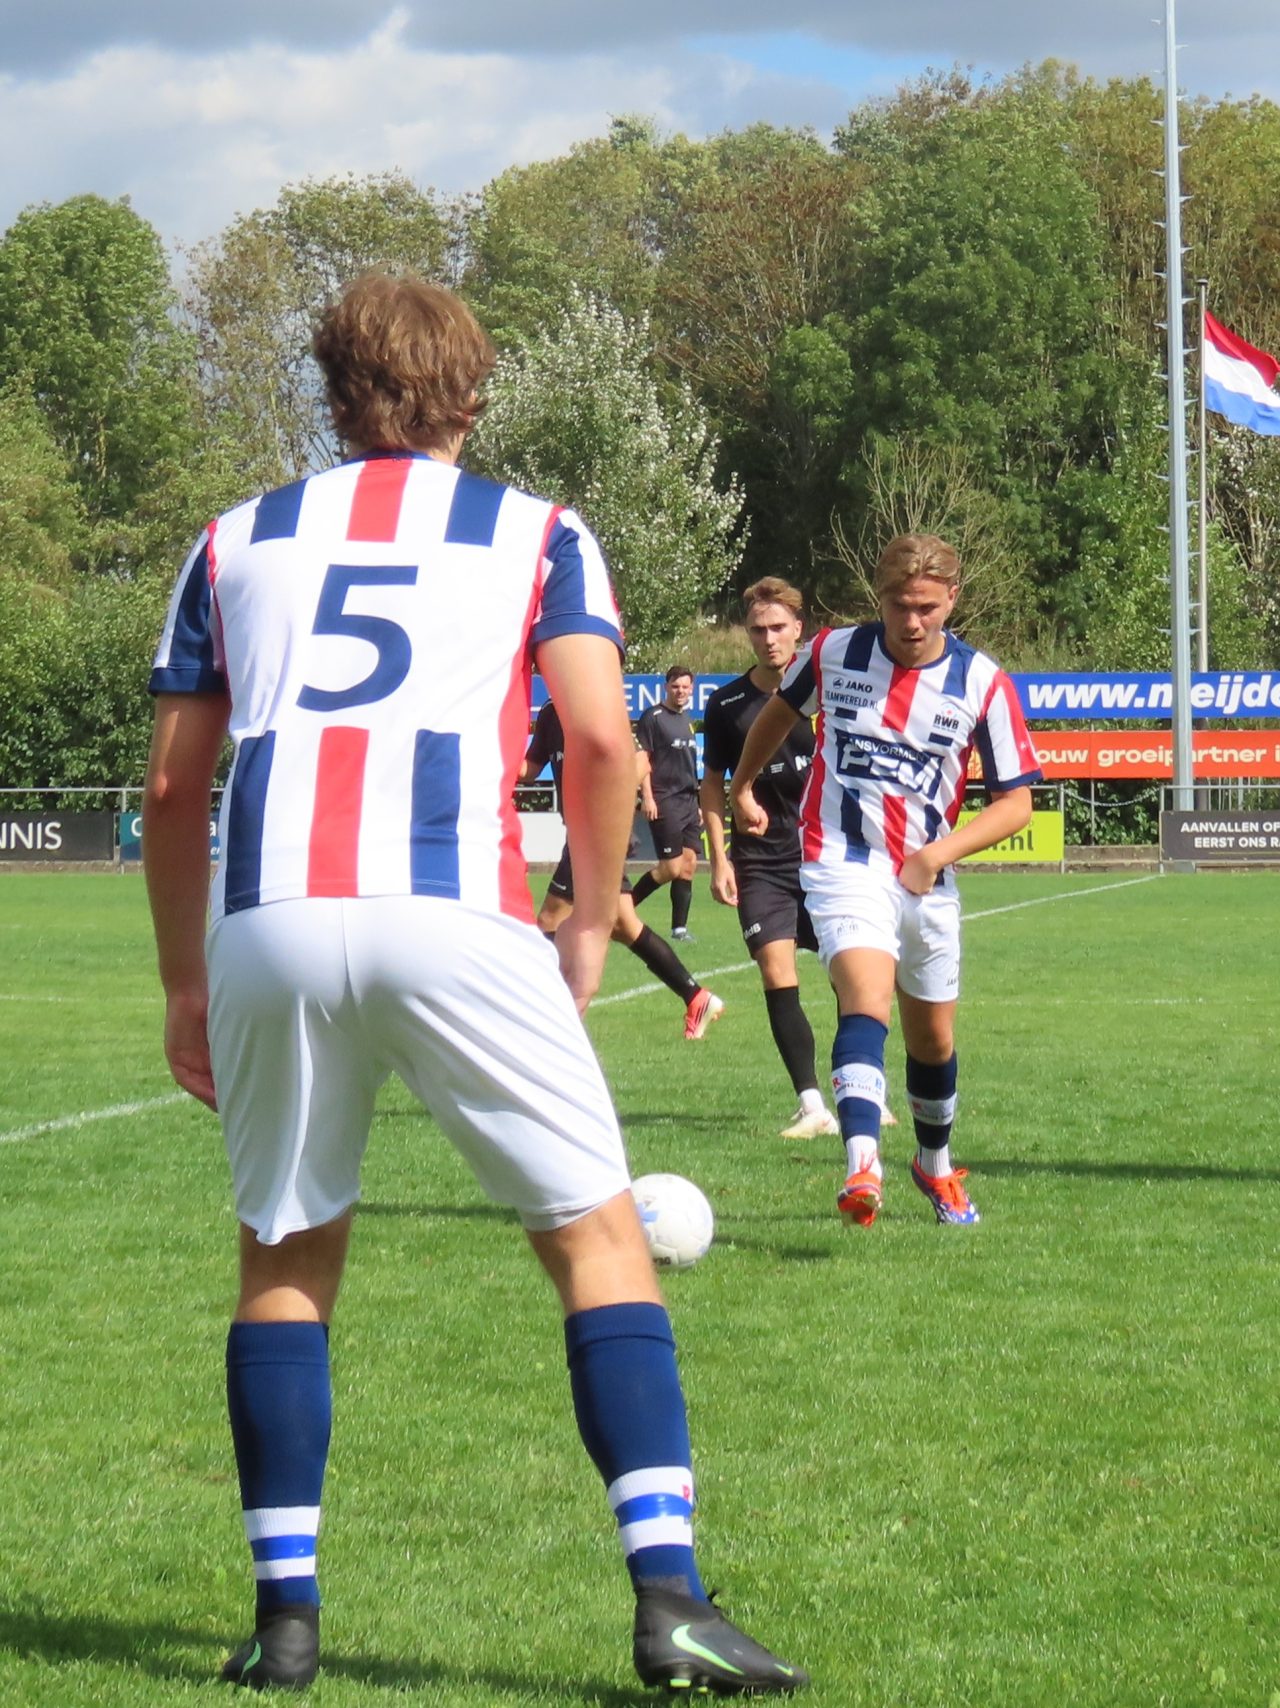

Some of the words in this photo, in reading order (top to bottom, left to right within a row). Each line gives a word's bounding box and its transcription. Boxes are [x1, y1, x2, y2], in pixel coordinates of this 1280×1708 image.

[296, 563, 418, 712] 5
[845, 680, 873, 693] JAKO
[934, 714, 960, 730] RWB
[1180, 822, 1259, 833] AANVALLEN
[1262, 822, 1280, 833] OF
[1195, 837, 1235, 848] EERST
[1238, 837, 1267, 848] ONS
